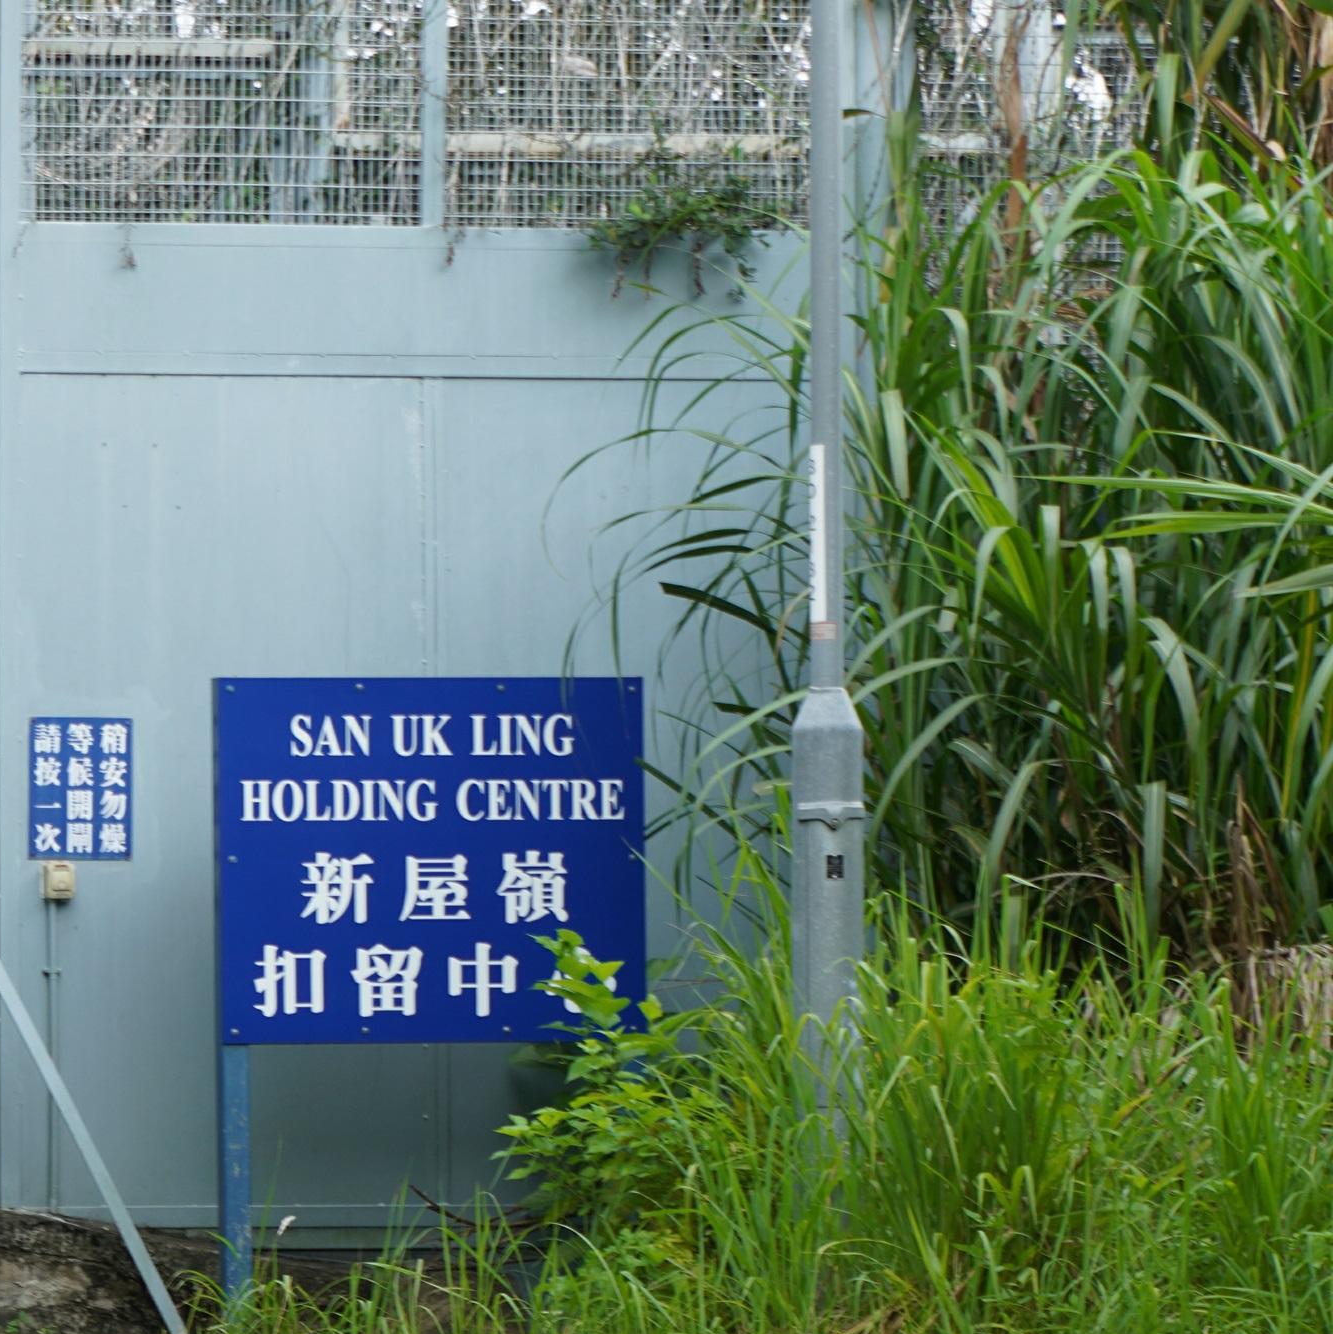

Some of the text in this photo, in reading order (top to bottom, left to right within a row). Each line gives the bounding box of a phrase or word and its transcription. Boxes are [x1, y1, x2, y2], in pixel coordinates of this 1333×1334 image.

[290, 714, 575, 757] SAN UK LING
[34, 724, 62, 853] 請按一次
[240, 778, 625, 822] HOLDING CENTRE
[300, 850, 569, 924] 新屋嶺
